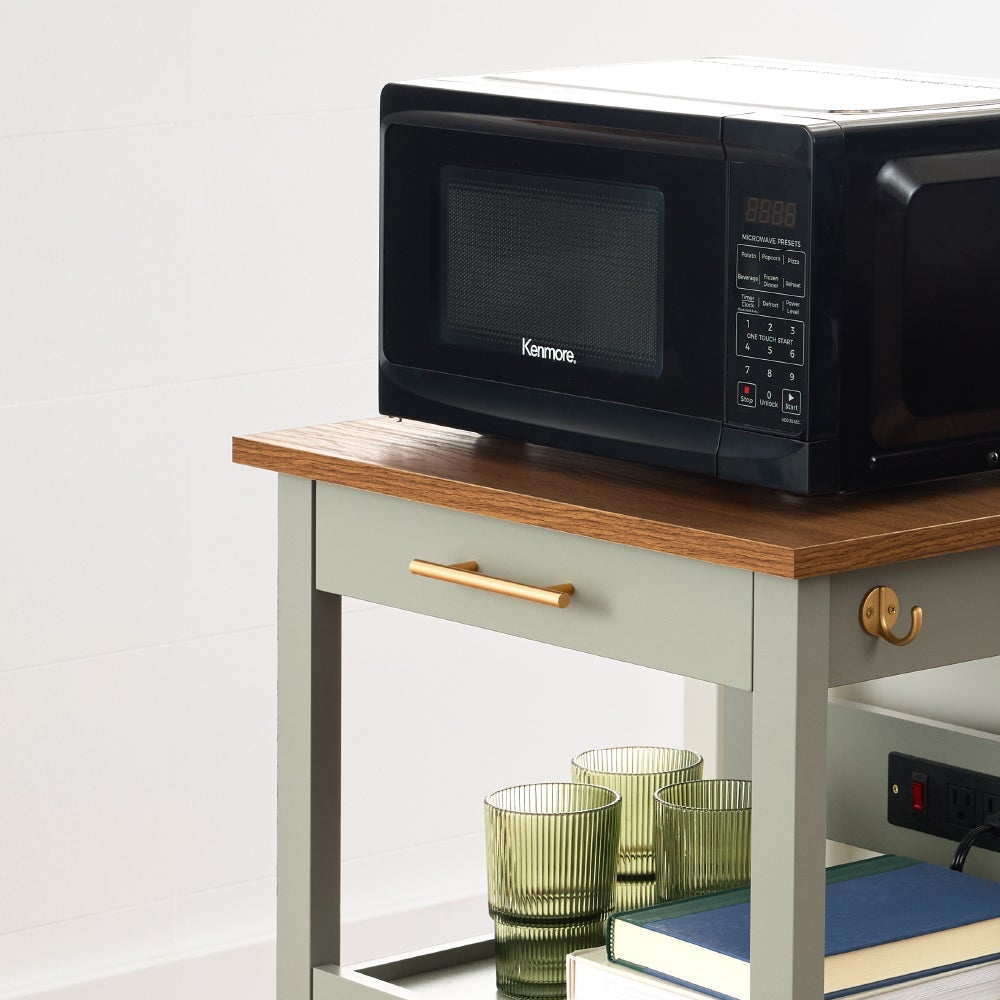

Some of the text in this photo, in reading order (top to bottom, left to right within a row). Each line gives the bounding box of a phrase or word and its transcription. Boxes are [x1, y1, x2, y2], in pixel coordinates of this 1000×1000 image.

[742, 234, 802, 248] MICROWAVE PRESETS
[762, 253, 781, 261] Popcorn
[787, 257, 800, 265] Pizza
[737, 273, 759, 282] Beverage
[767, 322, 773, 332] 2
[790, 326, 796, 335] 3
[746, 332, 794, 345] ONE TOUCH START
[745, 342, 751, 351] 4
[767, 346, 773, 355] 5
[789, 349, 795, 359] 6
[744, 365, 750, 374] 7
[767, 369, 773, 378] 8
[789, 372, 795, 381] 9
[740, 395, 754, 404] Stop
[760, 399, 779, 408] Unlock
[785, 403, 798, 411] Start
